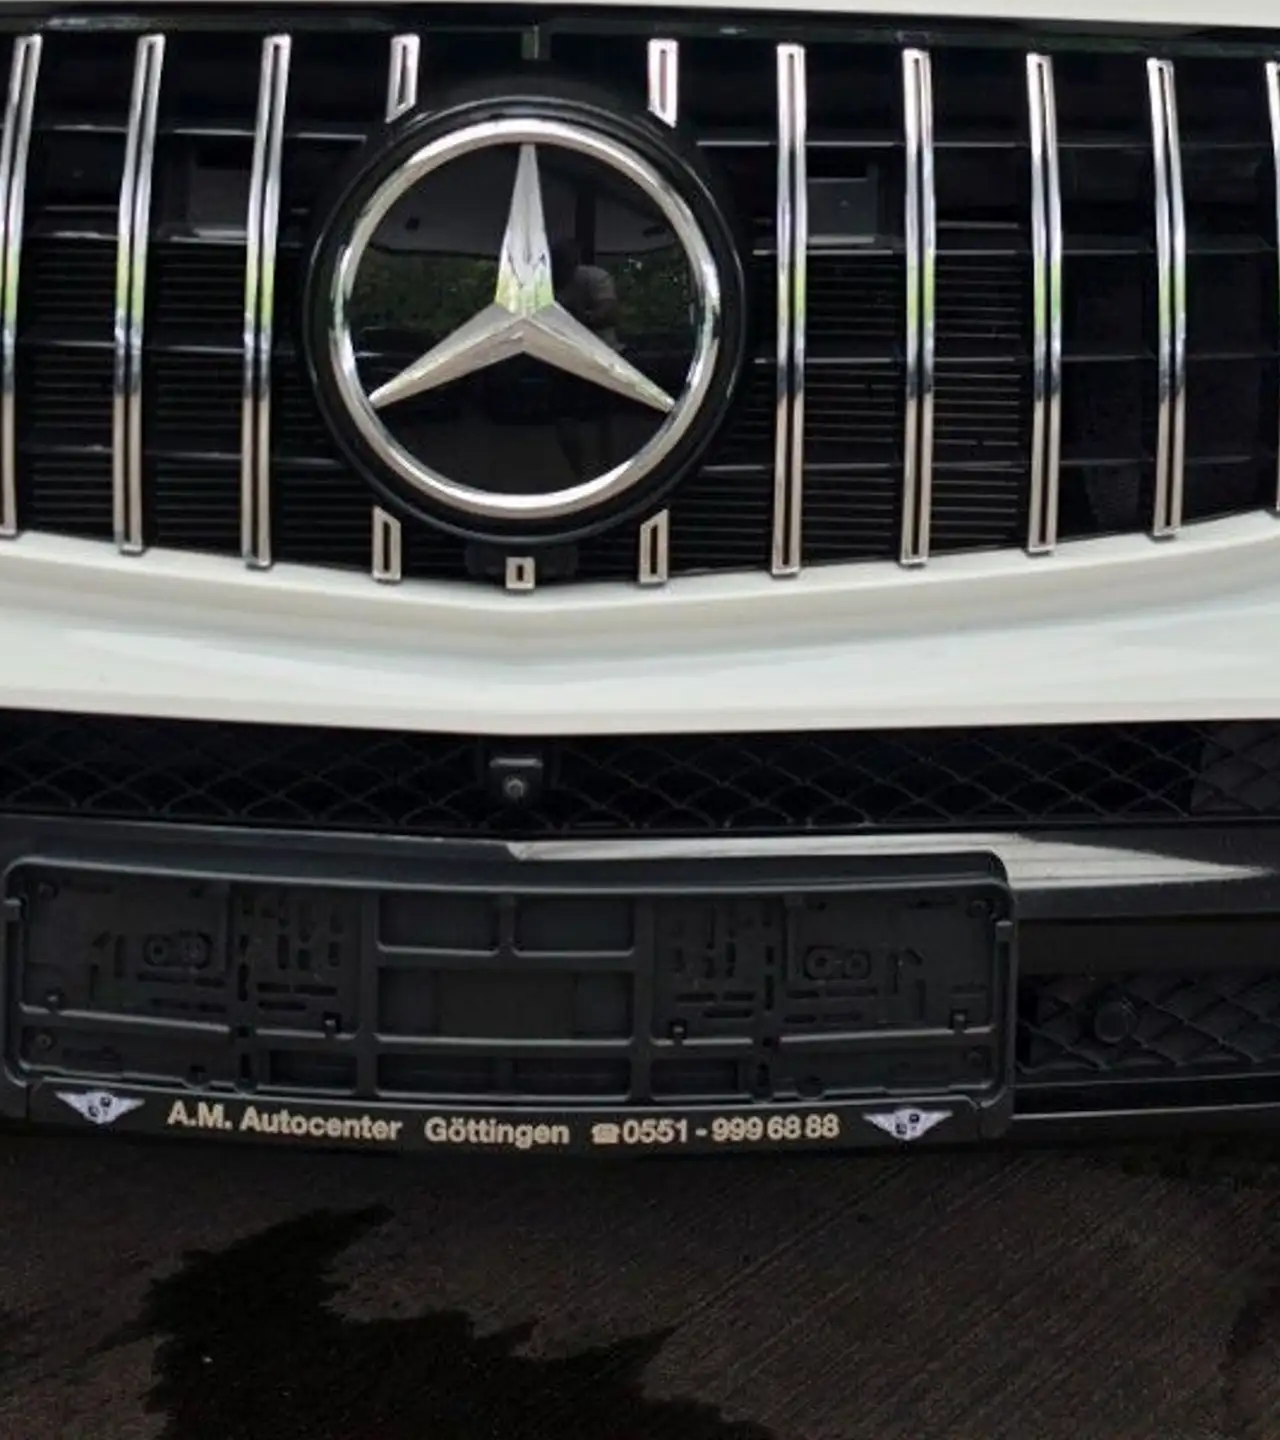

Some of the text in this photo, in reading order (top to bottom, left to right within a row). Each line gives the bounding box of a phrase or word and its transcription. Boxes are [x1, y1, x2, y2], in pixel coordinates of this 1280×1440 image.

[167, 1100, 233, 1129] A.M.
[239, 1105, 403, 1141] Autocenter
[424, 1116, 570, 1149] Göttingen
